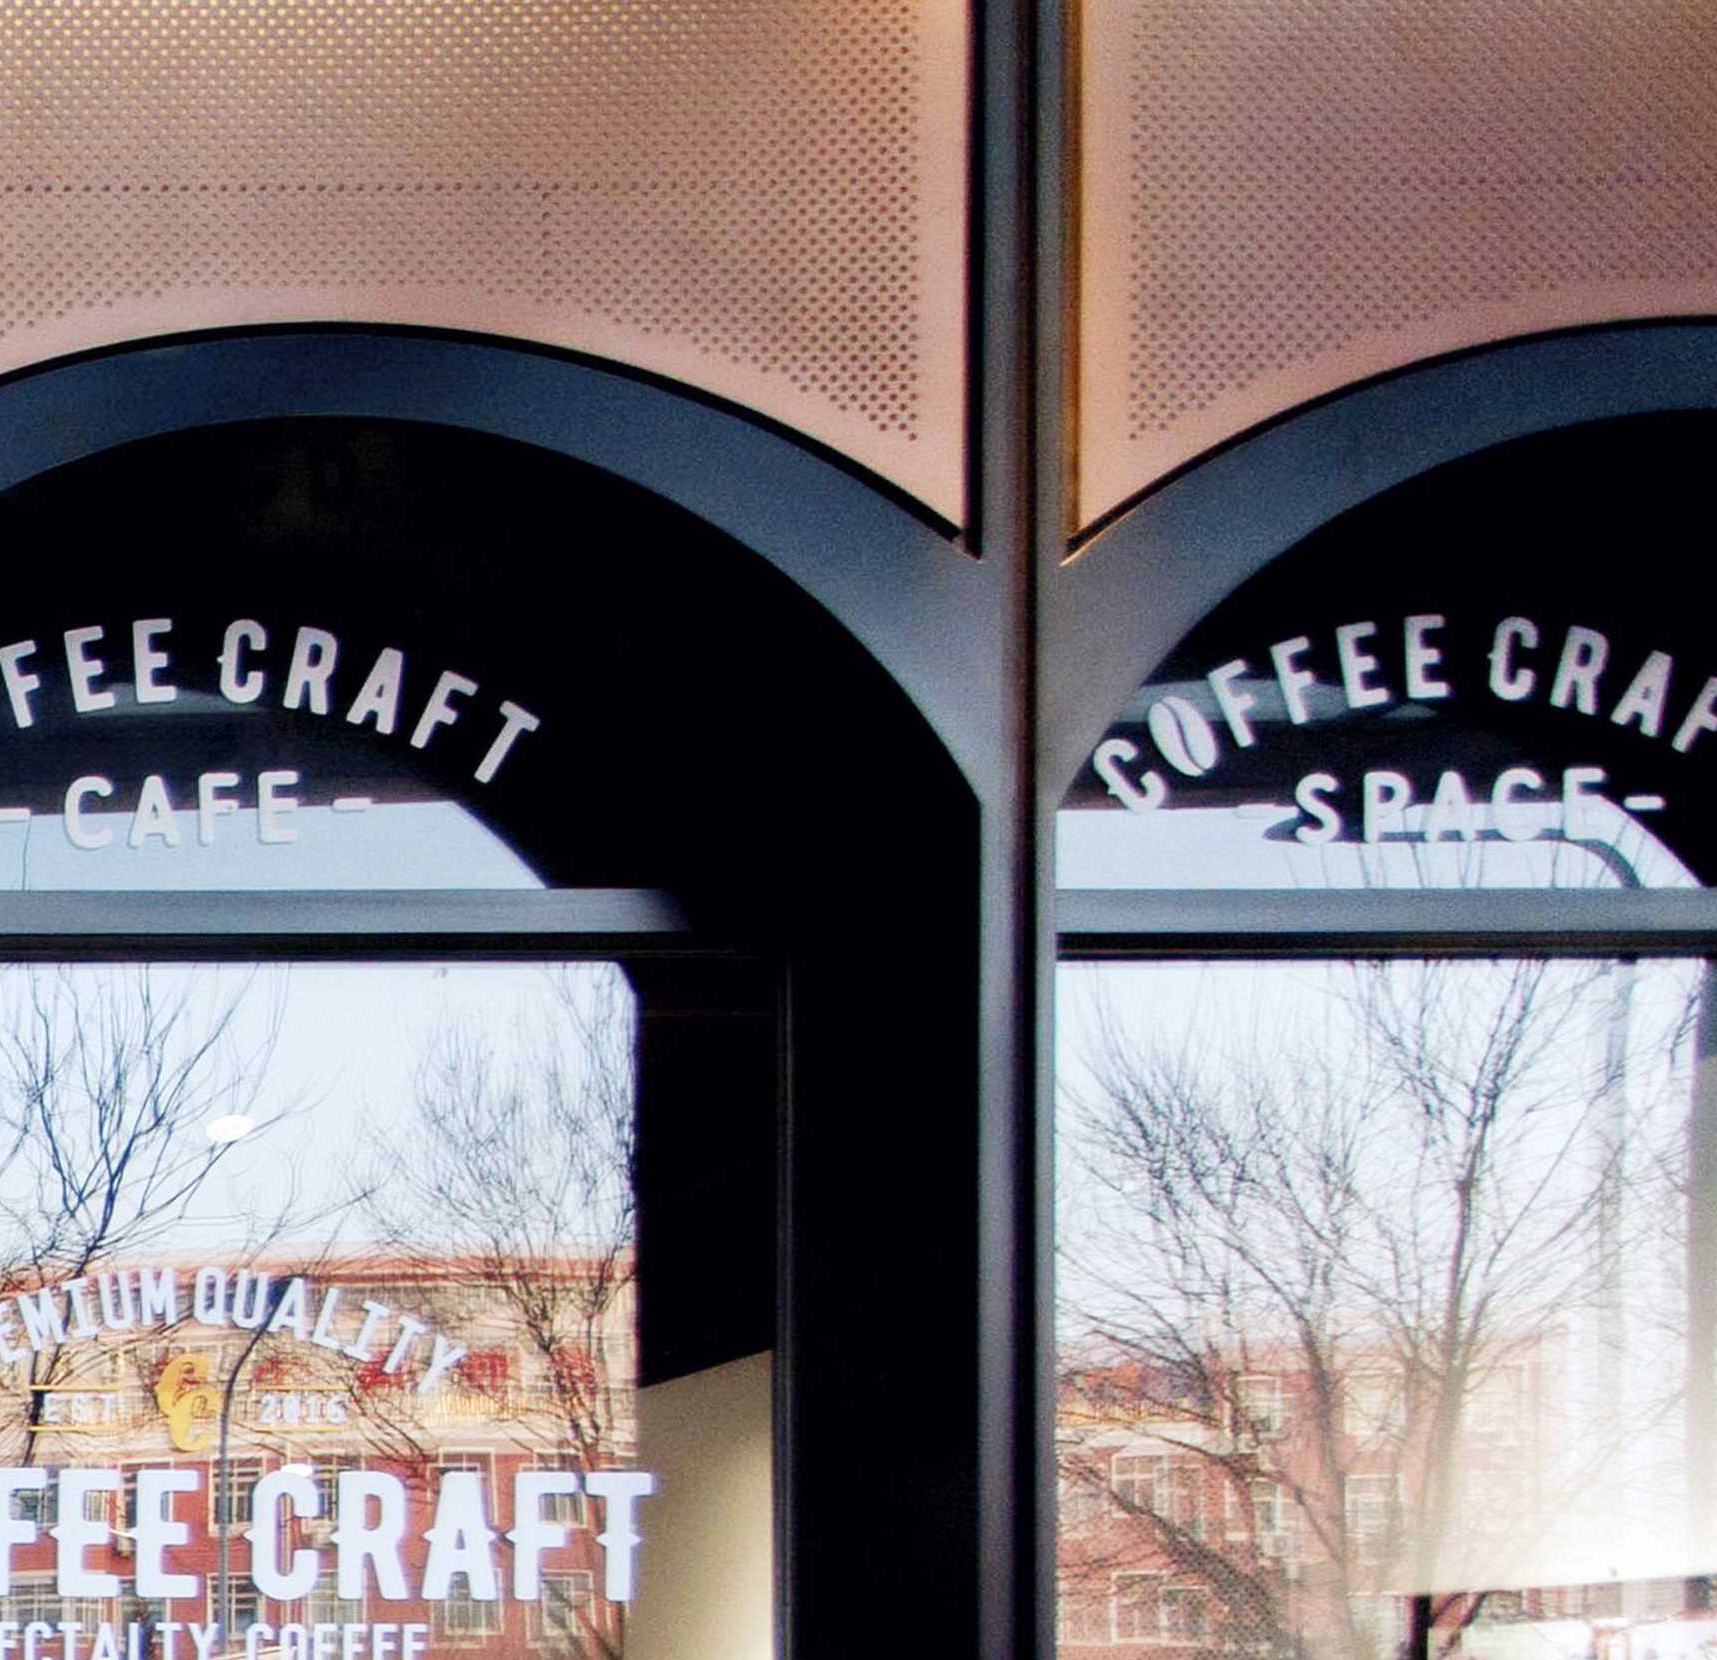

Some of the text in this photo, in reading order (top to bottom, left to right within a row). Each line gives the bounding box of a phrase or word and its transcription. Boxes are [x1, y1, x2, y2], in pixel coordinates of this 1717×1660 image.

[216, 619, 539, 784] CRAFT
[1092, 614, 1451, 816] COFFEE
[63, 770, 301, 849] CAFE
[193, 1265, 468, 1395] QUALITY
[43, 1392, 118, 1425] EST
[260, 1392, 348, 1425] 2016
[241, 1469, 655, 1603] CRAFT
